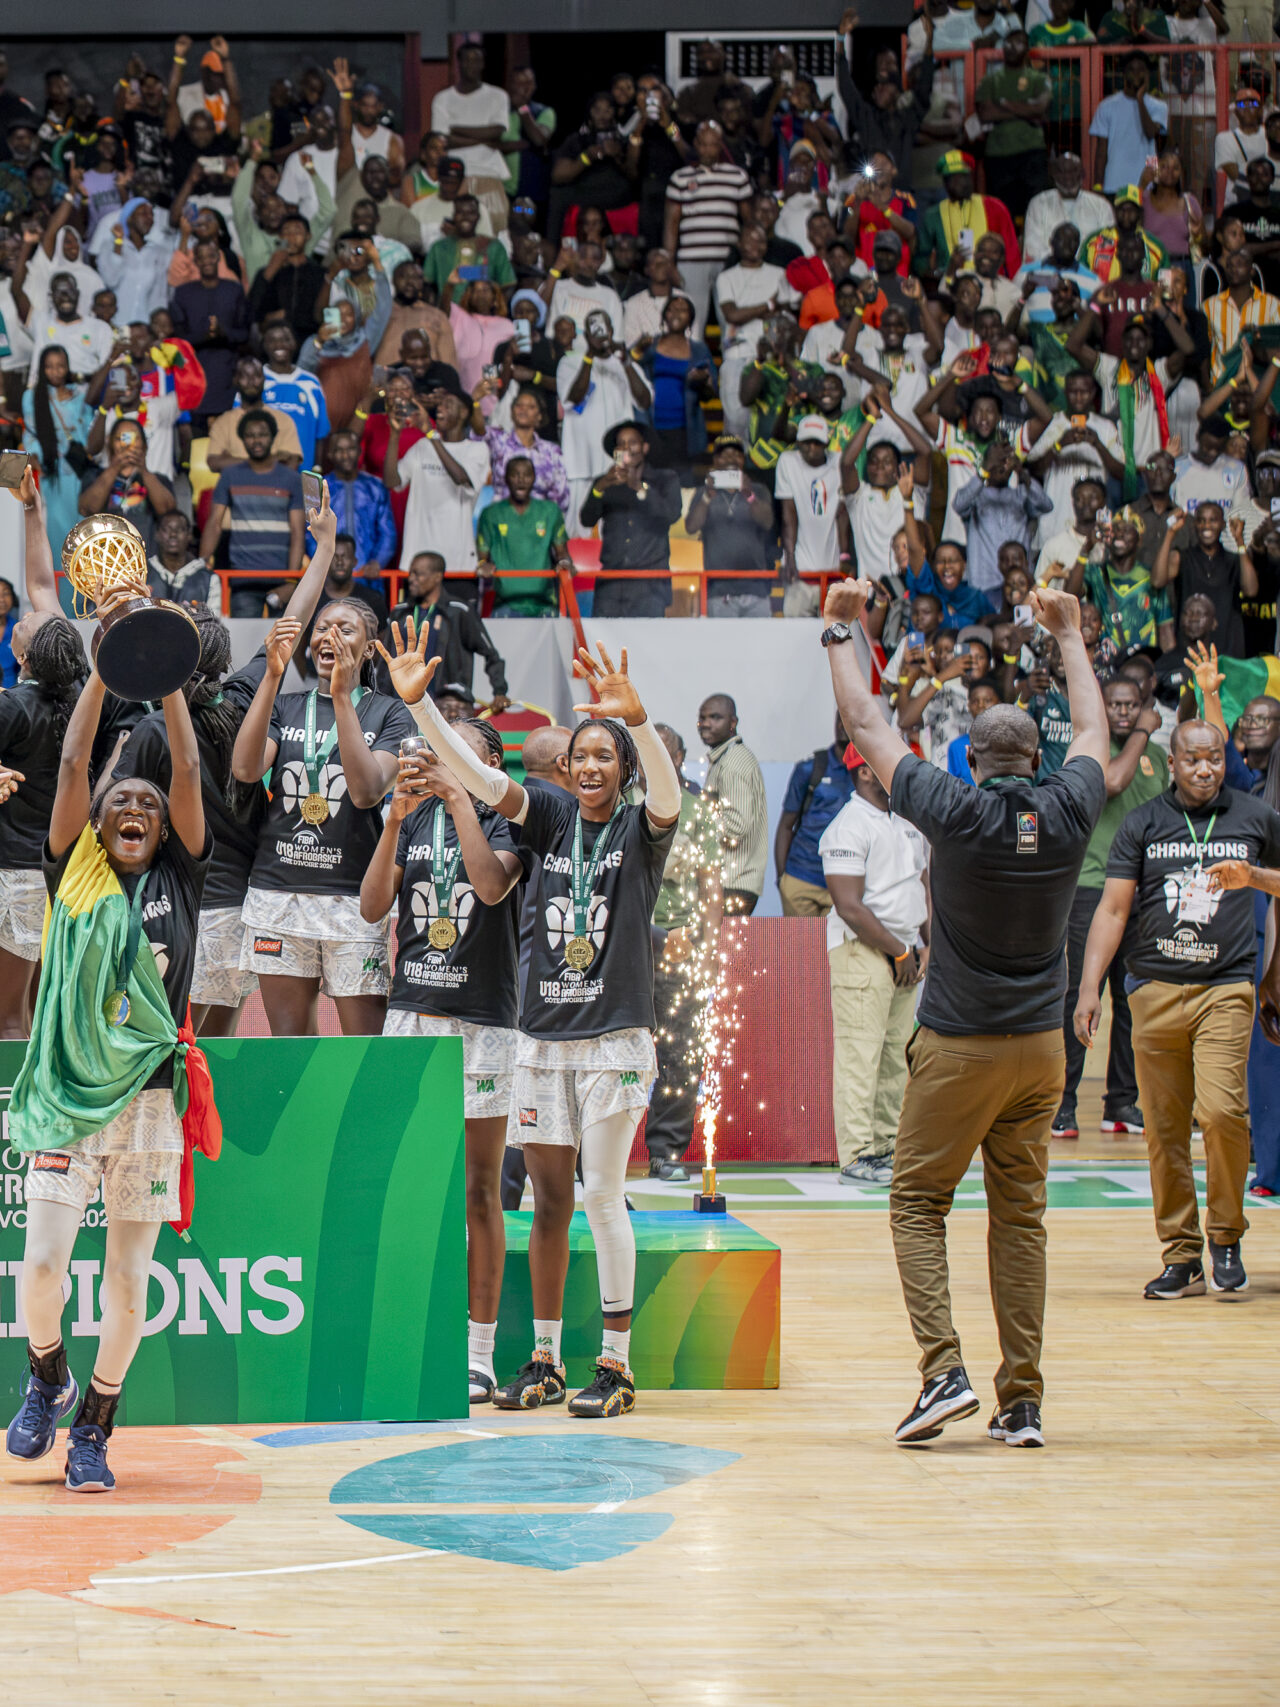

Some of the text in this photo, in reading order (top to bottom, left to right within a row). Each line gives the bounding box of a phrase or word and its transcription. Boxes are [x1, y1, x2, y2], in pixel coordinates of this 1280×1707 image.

[297, 835, 314, 845] FIBA
[276, 839, 342, 858] U18 WOMEN'S
[1146, 842, 1249, 859] CHAMPIONS
[294, 852, 342, 864] AFROBASKET
[1176, 941, 1219, 950] WOMEN'S
[427, 955, 442, 964] FIBA
[404, 961, 468, 978] U18 WOMEN'S
[422, 970, 469, 983] AFROBASKET
[564, 972, 581, 981] FIBA
[540, 978, 603, 997] U18 WOMEN'S
[620, 1070, 640, 1086] WA
[476, 1078, 496, 1093] WA
